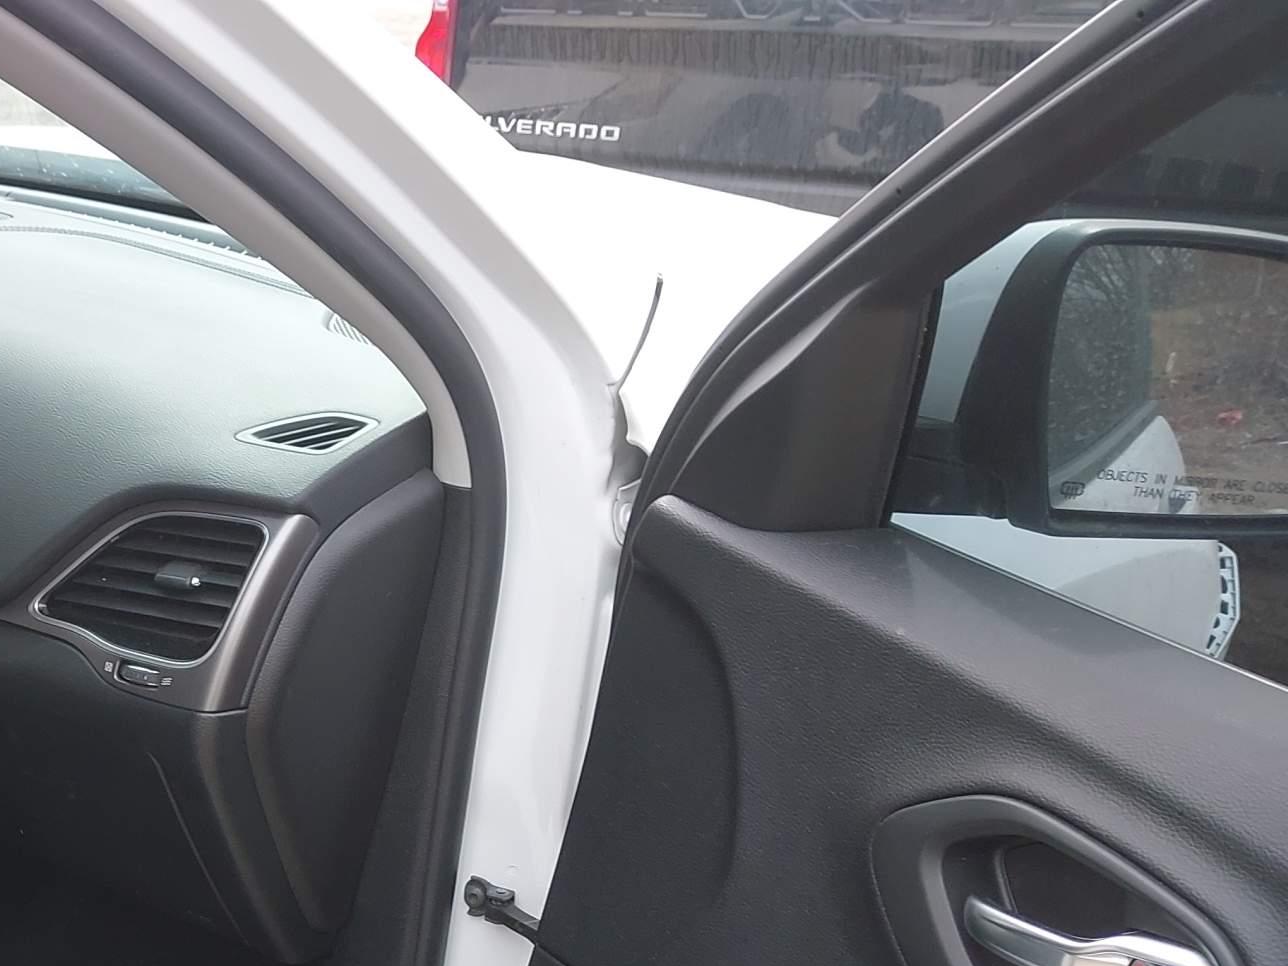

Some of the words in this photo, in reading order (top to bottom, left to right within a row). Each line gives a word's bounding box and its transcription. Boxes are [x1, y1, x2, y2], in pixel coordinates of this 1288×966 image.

[483, 115, 621, 142] LVERADO
[1096, 469, 1149, 484] OBJECTS
[1154, 473, 1168, 485] IN
[1223, 479, 1248, 492] ARE
[1133, 485, 1165, 499] THAN
